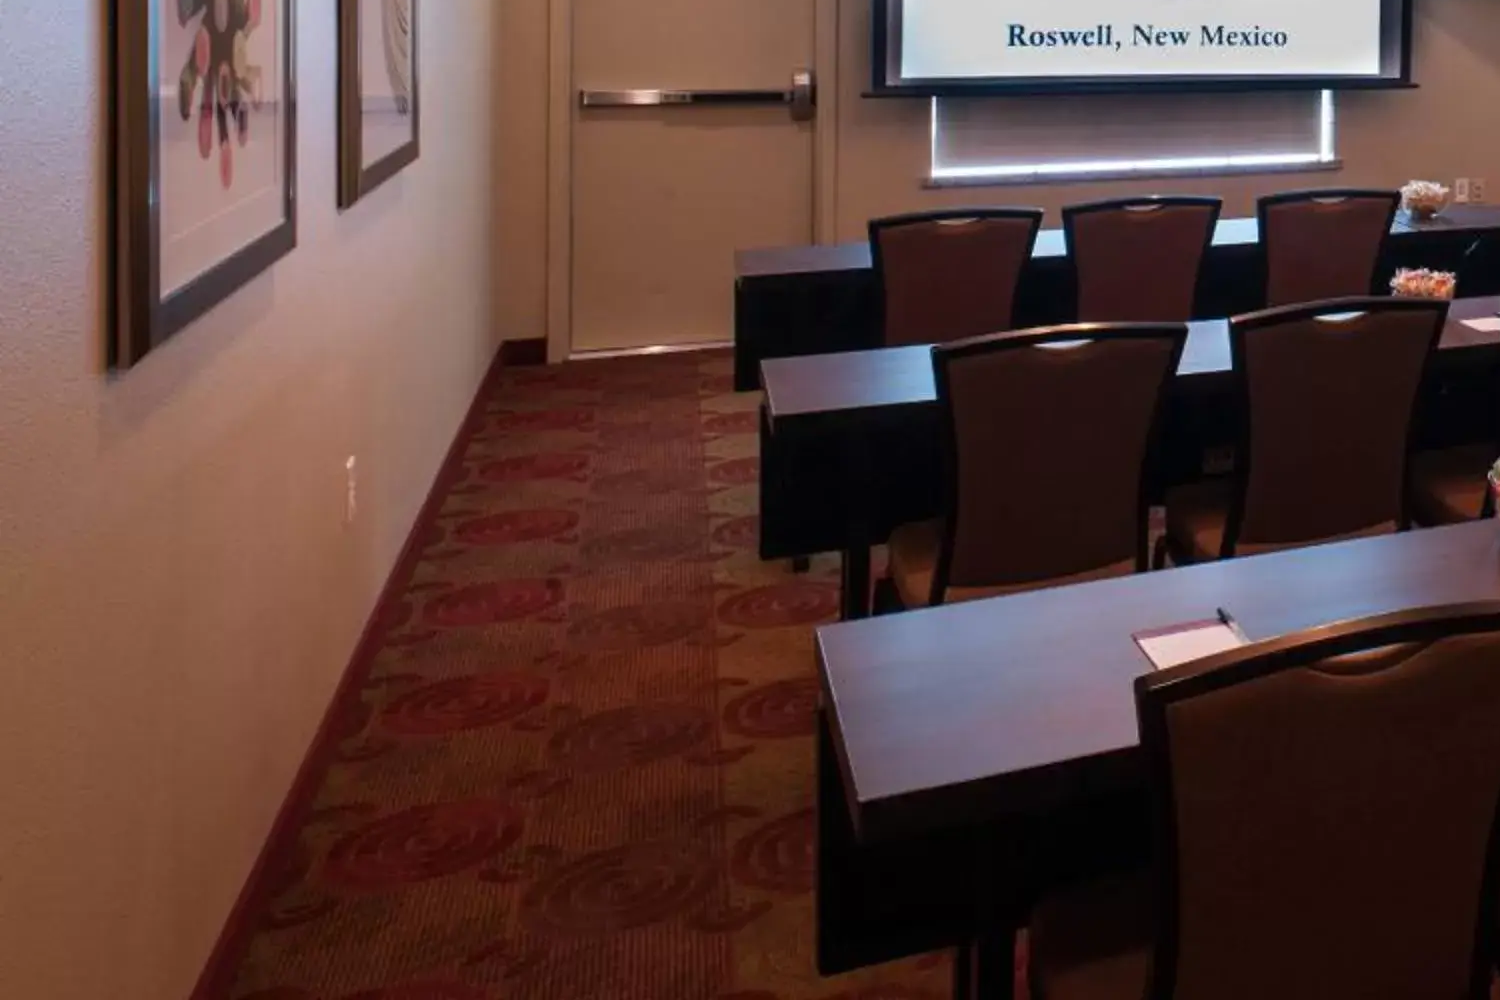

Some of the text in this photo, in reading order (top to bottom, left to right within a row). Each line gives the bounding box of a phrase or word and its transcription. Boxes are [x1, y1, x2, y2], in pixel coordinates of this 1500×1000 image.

[1006, 23, 1288, 51] Roswell, New Mexico
